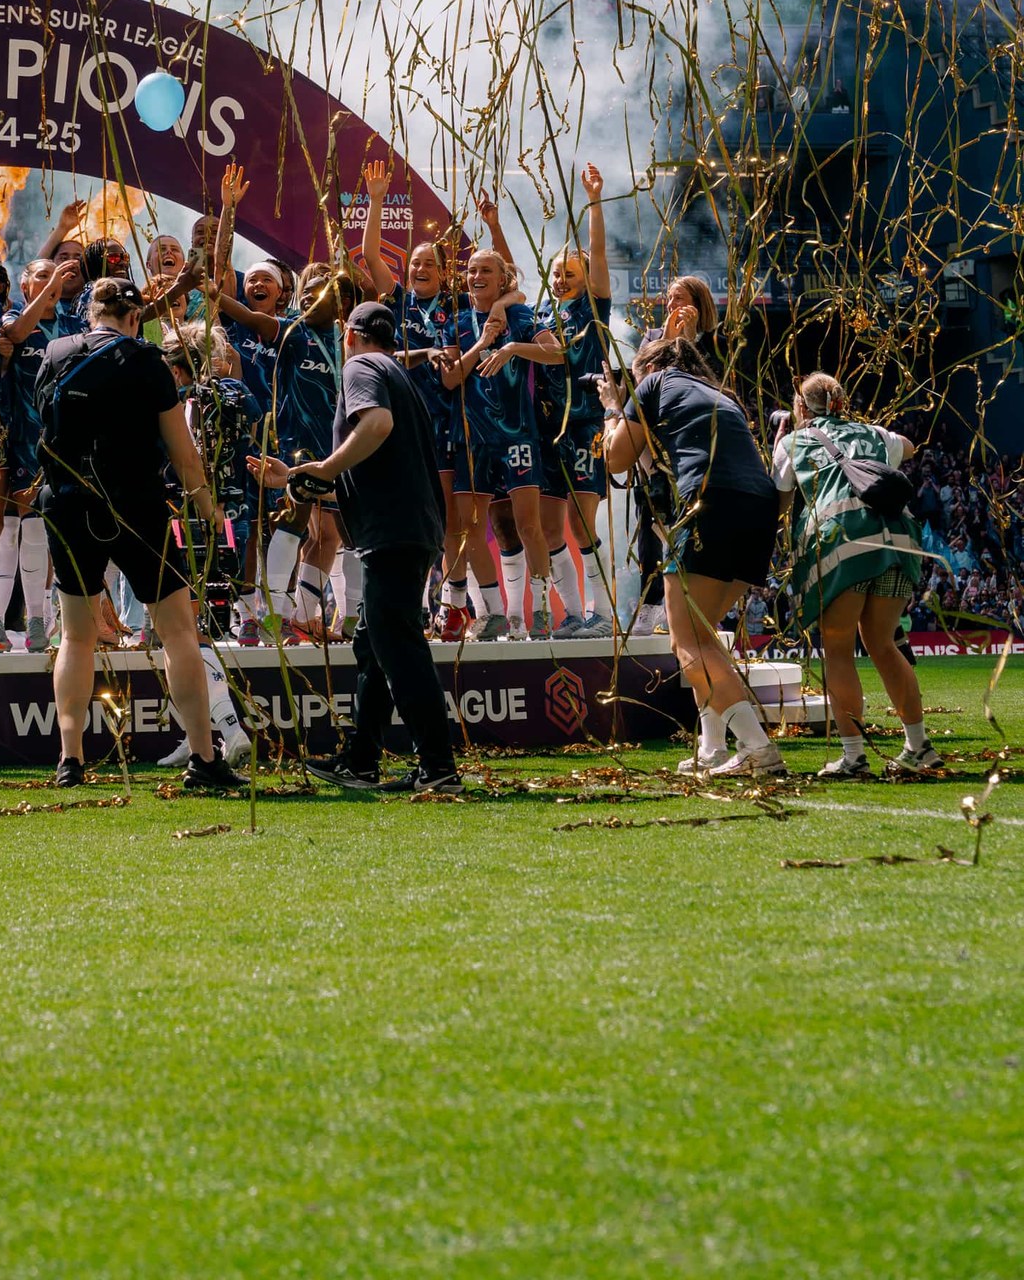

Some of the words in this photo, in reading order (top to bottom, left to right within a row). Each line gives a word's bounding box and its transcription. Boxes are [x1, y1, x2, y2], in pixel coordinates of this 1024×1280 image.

[49, 9, 117, 38] SUPER
[123, 24, 206, 67] LEAGUE
[356, 193, 413, 206] BALAYS
[341, 207, 413, 220] WOEN'S
[342, 220, 367, 230] SUPE
[380, 220, 413, 230] EAGUE
[507, 443, 532, 468] 33
[574, 448, 595, 473] 21
[10, 698, 219, 737] WMEN
[243, 693, 360, 729] SUPE
[391, 687, 527, 725] AGUE
